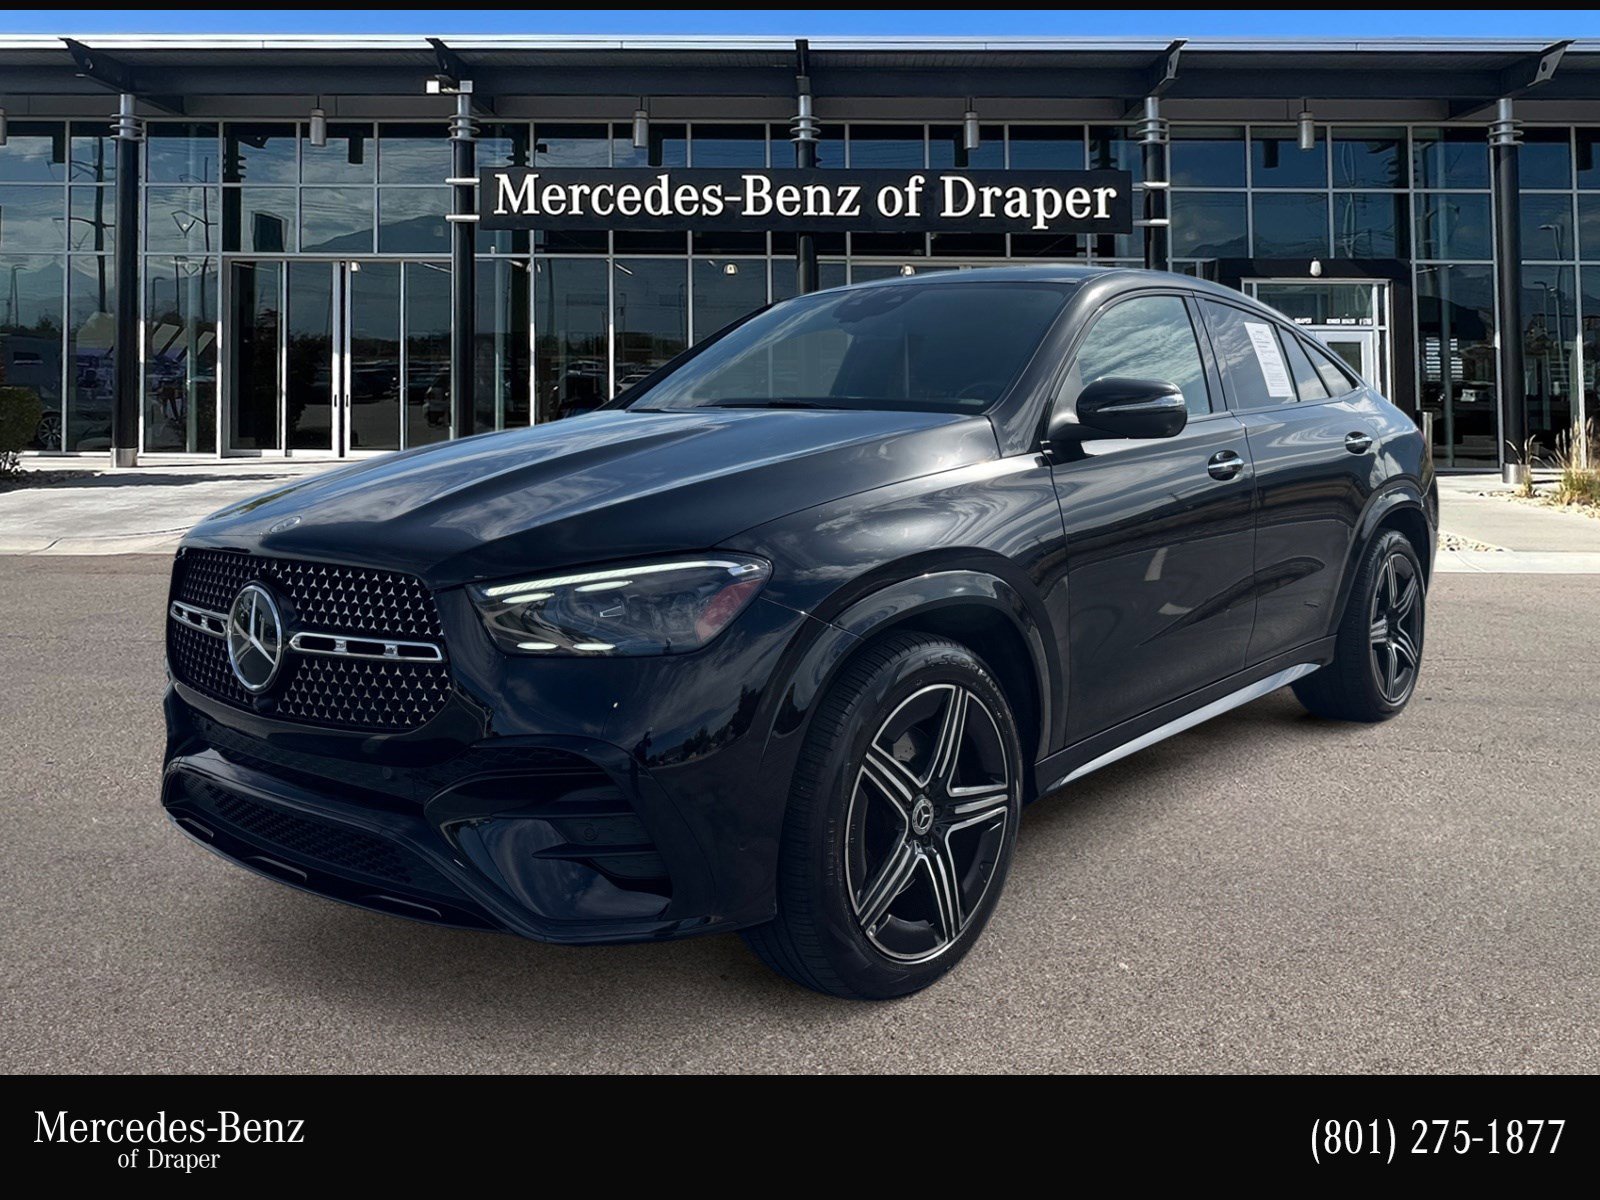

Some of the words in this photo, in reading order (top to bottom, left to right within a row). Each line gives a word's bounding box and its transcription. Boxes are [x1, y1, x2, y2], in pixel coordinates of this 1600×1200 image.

[494, 173, 861, 218] Mercedes-Benz
[877, 174, 926, 217] of
[939, 175, 1117, 230] Draper
